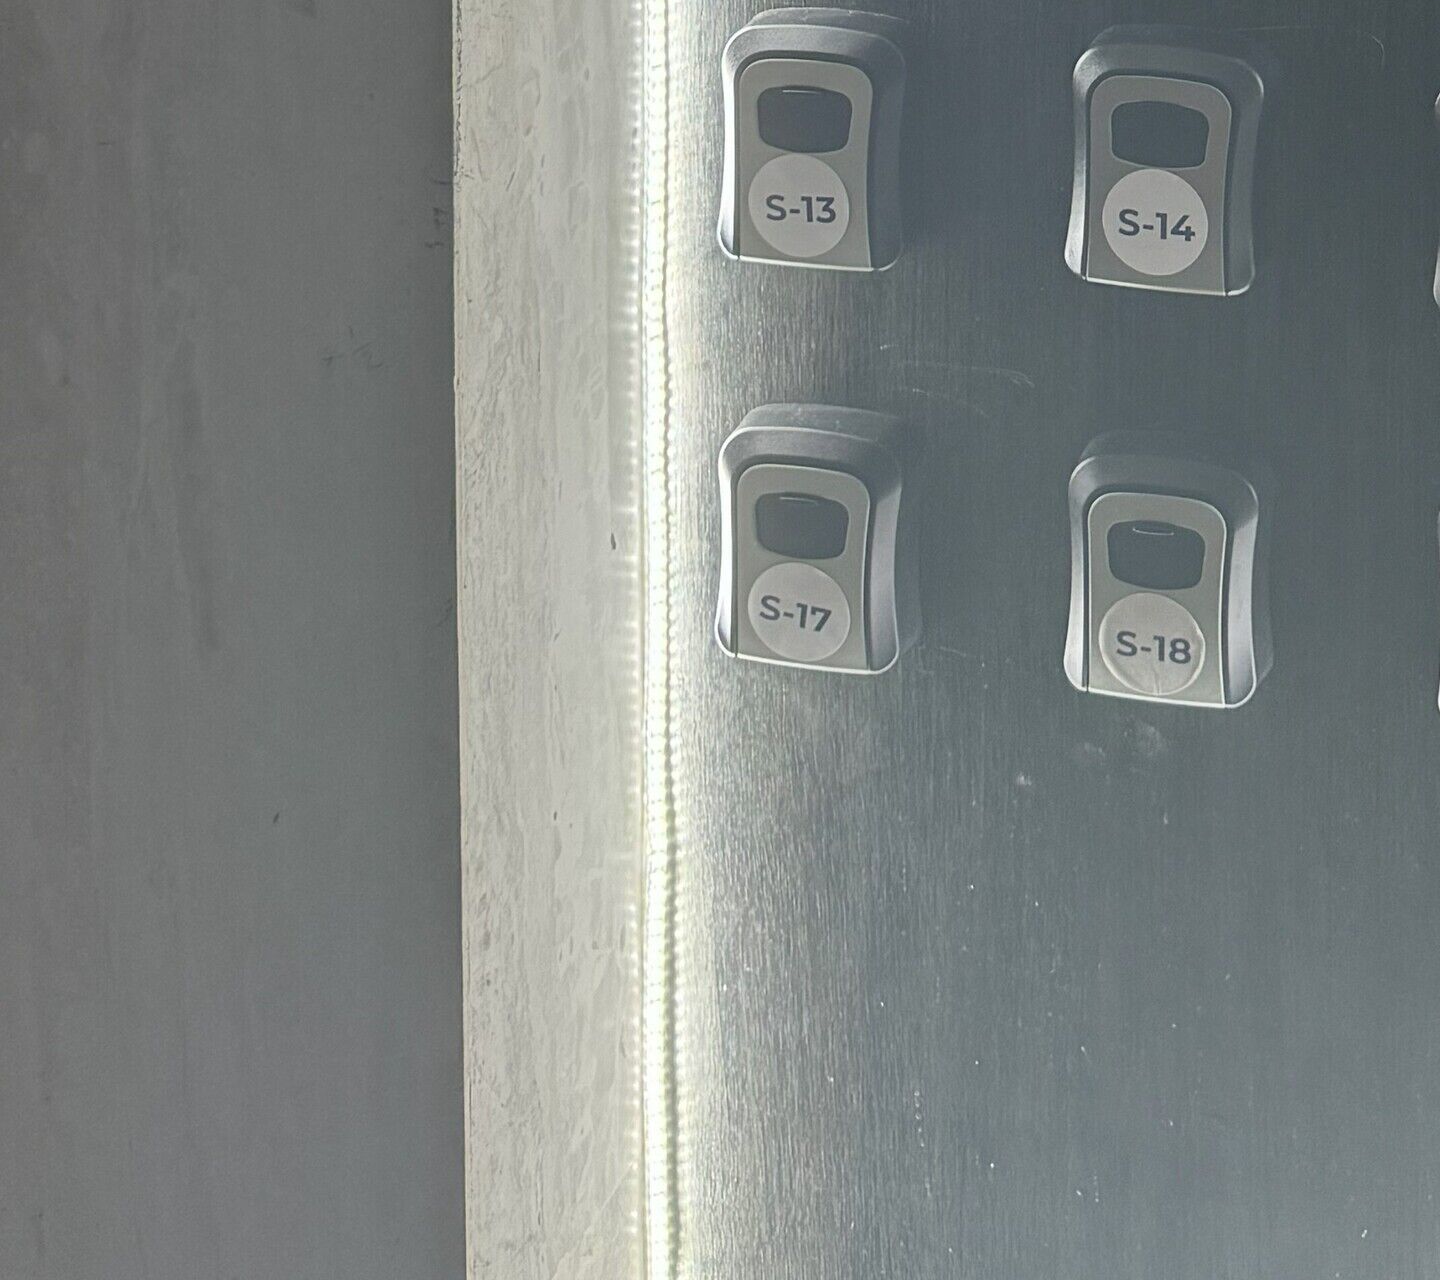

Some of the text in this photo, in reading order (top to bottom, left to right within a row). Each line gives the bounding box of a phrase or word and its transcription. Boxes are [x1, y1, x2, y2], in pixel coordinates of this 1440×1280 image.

[765, 194, 837, 224] S-13
[1118, 208, 1196, 242] S-14
[759, 595, 832, 632] S-17
[1116, 630, 1192, 665] S-18
